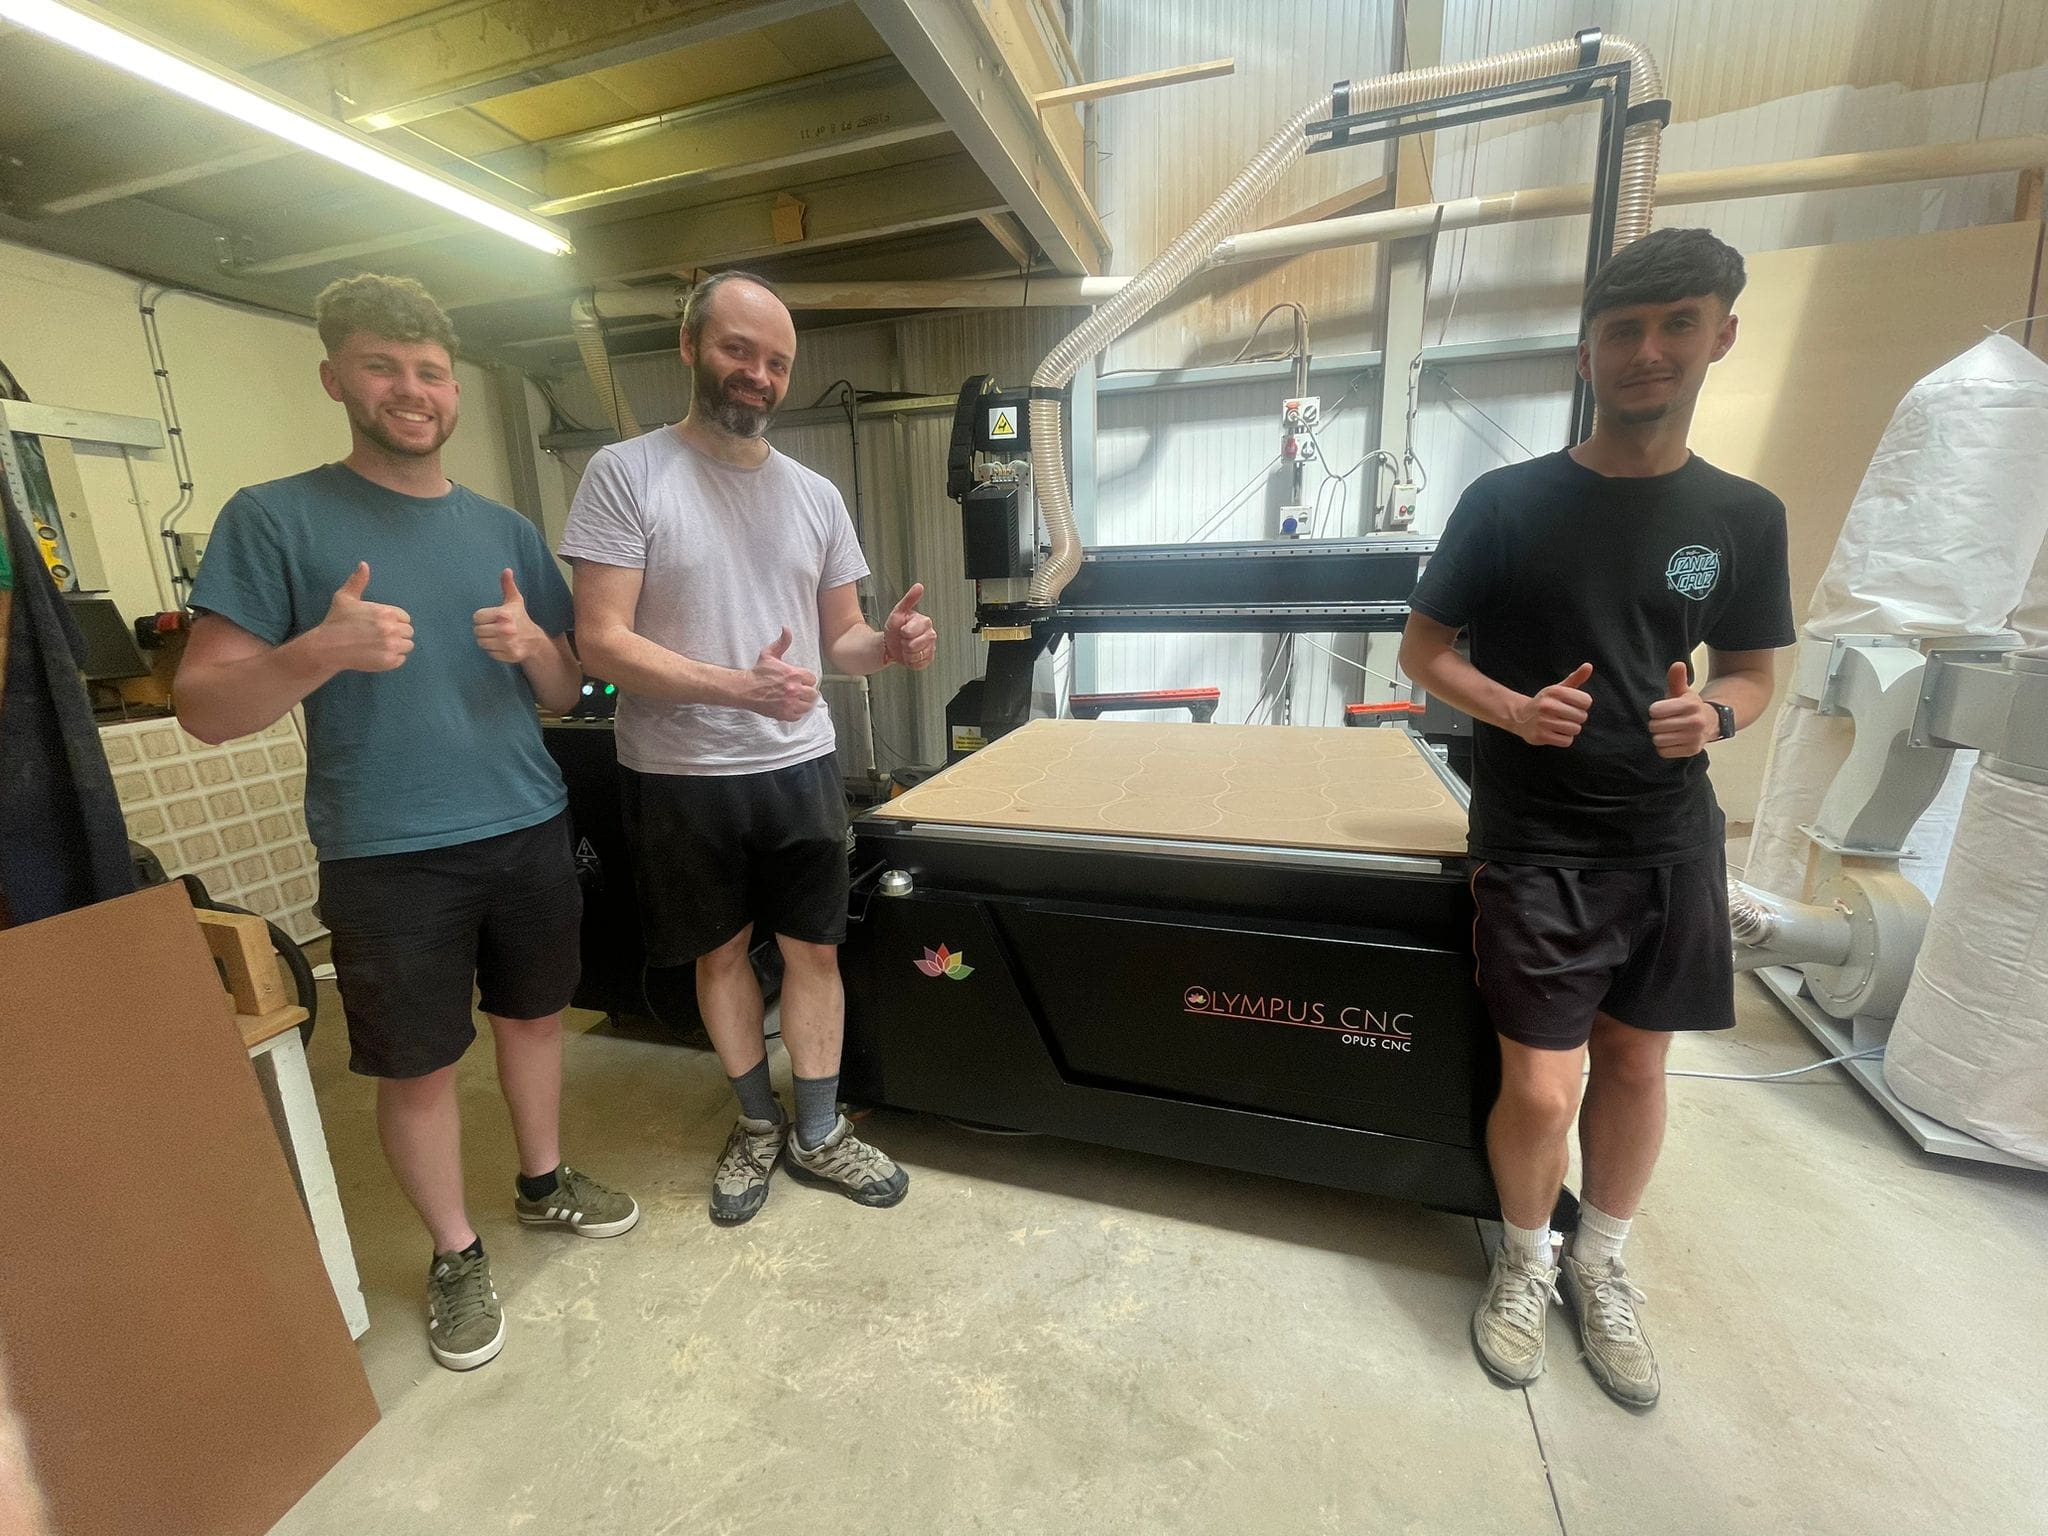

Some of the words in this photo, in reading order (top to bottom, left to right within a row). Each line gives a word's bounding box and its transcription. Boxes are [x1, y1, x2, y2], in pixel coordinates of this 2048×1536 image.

[1665, 553, 1717, 576] SANTA
[1677, 571, 1715, 592] CRUZ
[1184, 986, 1324, 1025] OLYMPUS
[1340, 1007, 1413, 1035] CNC
[1341, 1034, 1377, 1048] OPUS
[1381, 1039, 1411, 1052] CNC
